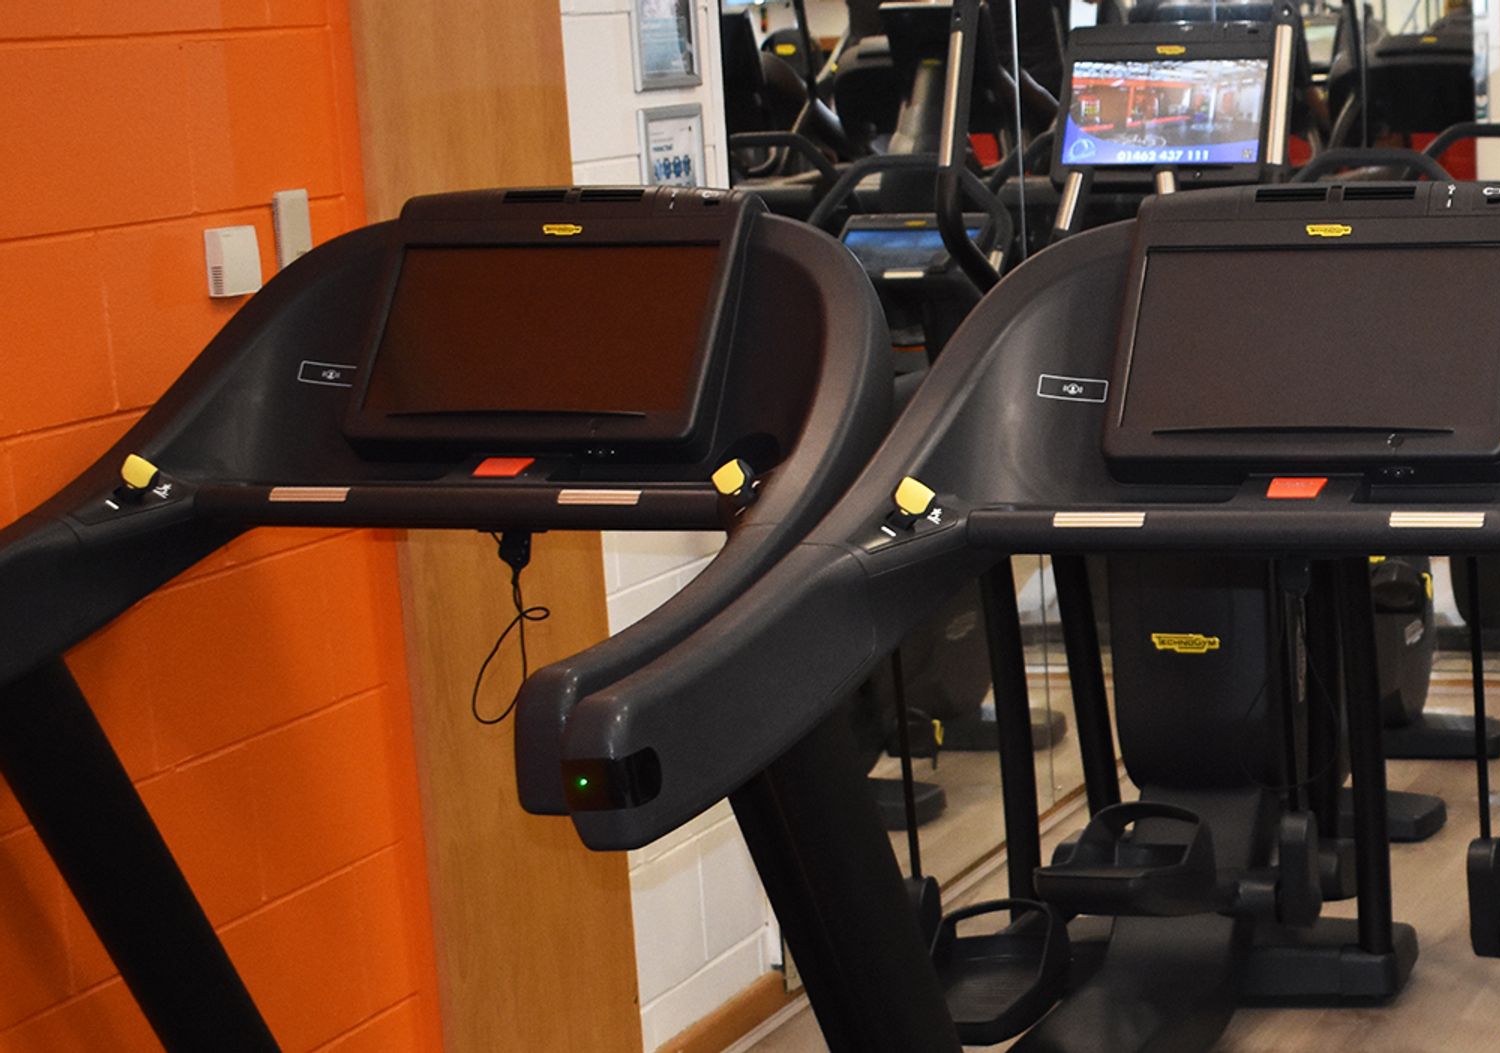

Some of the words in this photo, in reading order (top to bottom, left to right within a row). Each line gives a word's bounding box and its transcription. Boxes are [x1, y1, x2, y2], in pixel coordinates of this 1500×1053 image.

[1117, 150, 1157, 162] 01462
[1159, 150, 1184, 162] 437
[1187, 150, 1209, 161] 111
